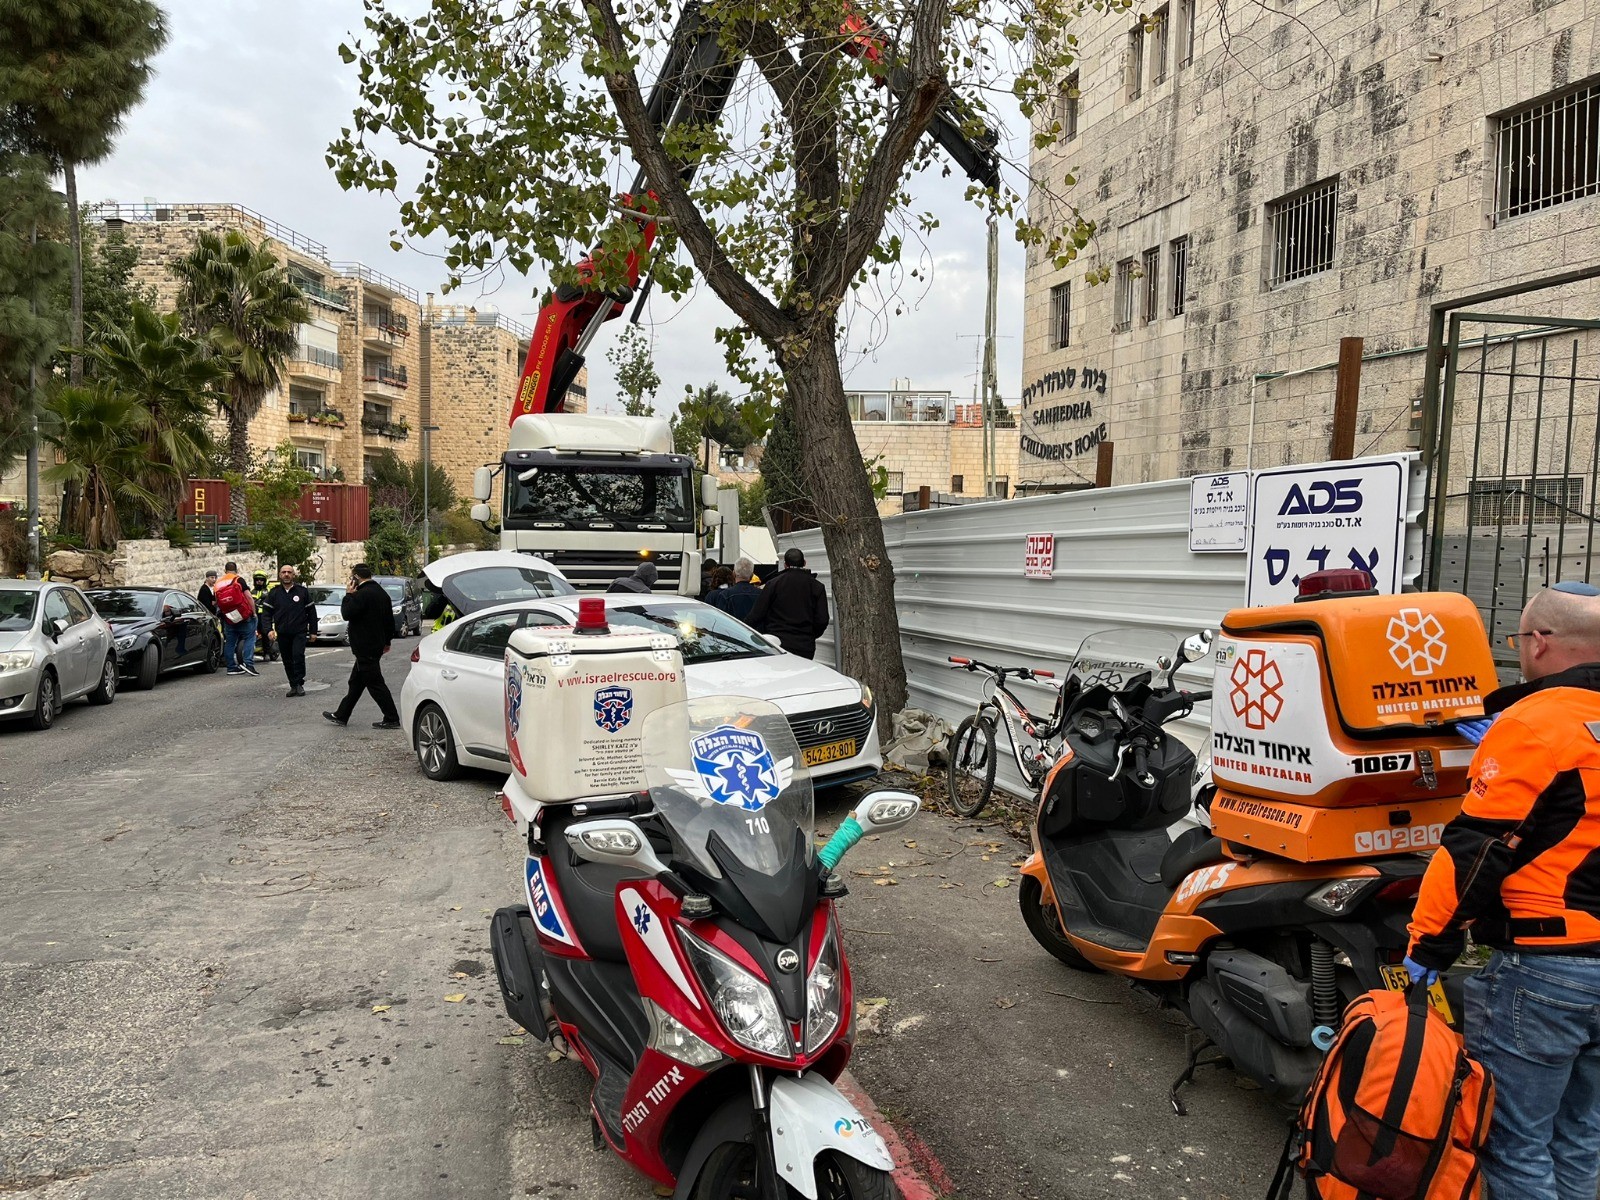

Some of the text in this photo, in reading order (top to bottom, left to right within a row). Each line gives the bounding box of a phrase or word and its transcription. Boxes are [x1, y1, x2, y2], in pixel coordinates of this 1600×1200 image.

[524, 373, 540, 411] PALFINGER
[1022, 366, 1107, 409] בית סנהדריה
[1033, 400, 1092, 426] SANHEDRIA
[1020, 422, 1107, 460] CHILDREN'S HOME
[1210, 477, 1230, 487] ADS
[1206, 490, 1233, 504] א.ד.ס
[1278, 478, 1363, 515] ADS
[1308, 521, 1321, 529] בניה
[1322, 520, 1335, 528] כוכב
[1335, 517, 1362, 528] א.ד.ס
[1041, 556, 1052, 569] כאן
[1372, 675, 1479, 700] איחוד הצלה
[1377, 694, 1482, 714] UNITED HATZALAH
[696, 735, 761, 756] איחוד הצלה
[1214, 732, 1313, 765] איחוד הצלה
[1213, 756, 1312, 784] UNITED HATZALAH
[1351, 754, 1412, 774] 1067
[1218, 795, 1303, 829] www.israelrescue.org
[745, 816, 770, 836] 710
[622, 1065, 685, 1134] איחוד הצלה
